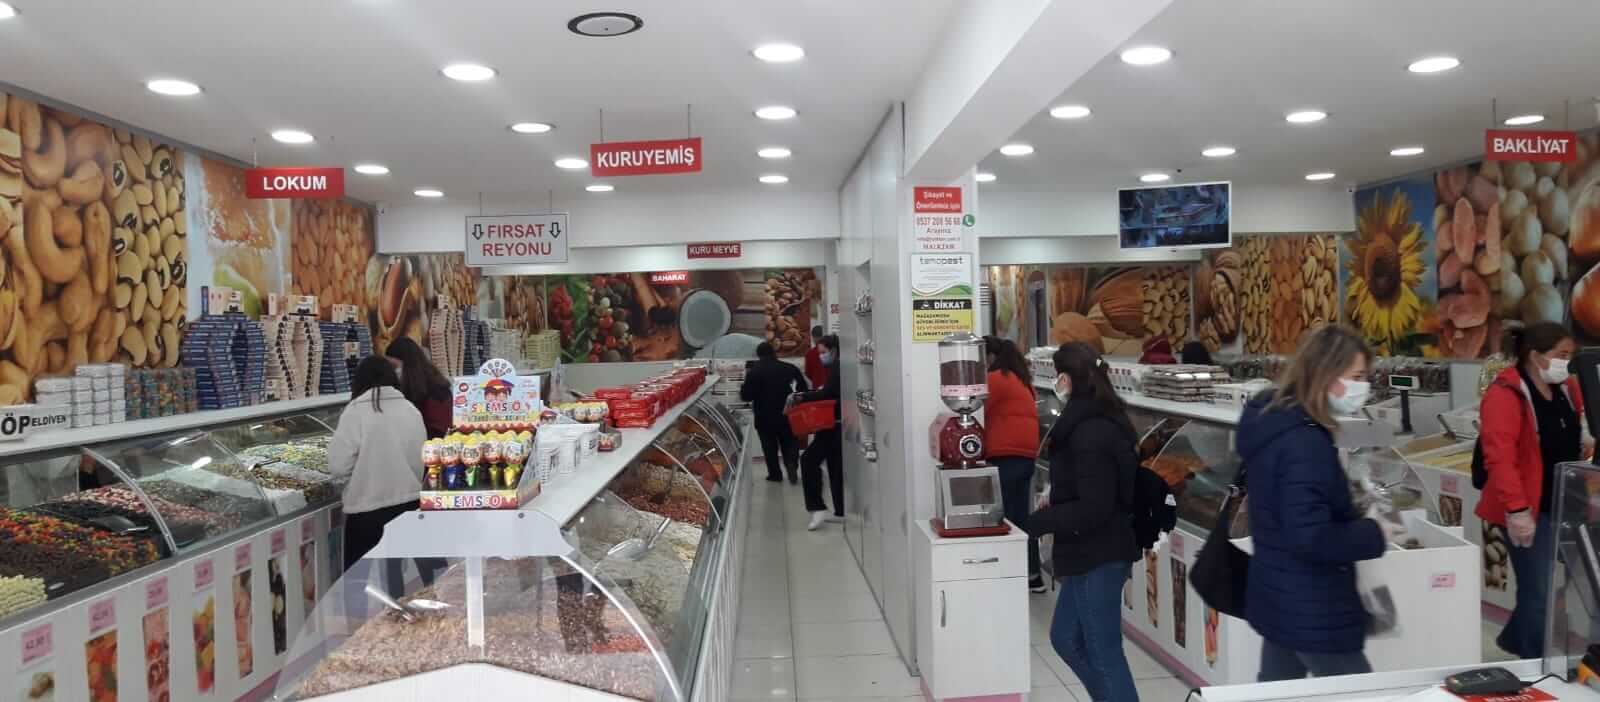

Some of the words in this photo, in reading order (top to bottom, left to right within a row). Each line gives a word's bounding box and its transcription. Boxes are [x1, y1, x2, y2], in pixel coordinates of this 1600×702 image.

[1493, 136, 1569, 154] BAKLİYAT
[597, 145, 695, 168] KURUYEMİŞ
[263, 175, 327, 191] LOKUM
[487, 223, 545, 239] FIRSAT
[482, 241, 552, 257] REYONU
[689, 245, 712, 255] KURU
[713, 244, 739, 254] MEYVE
[934, 300, 966, 309] DİKKAT
